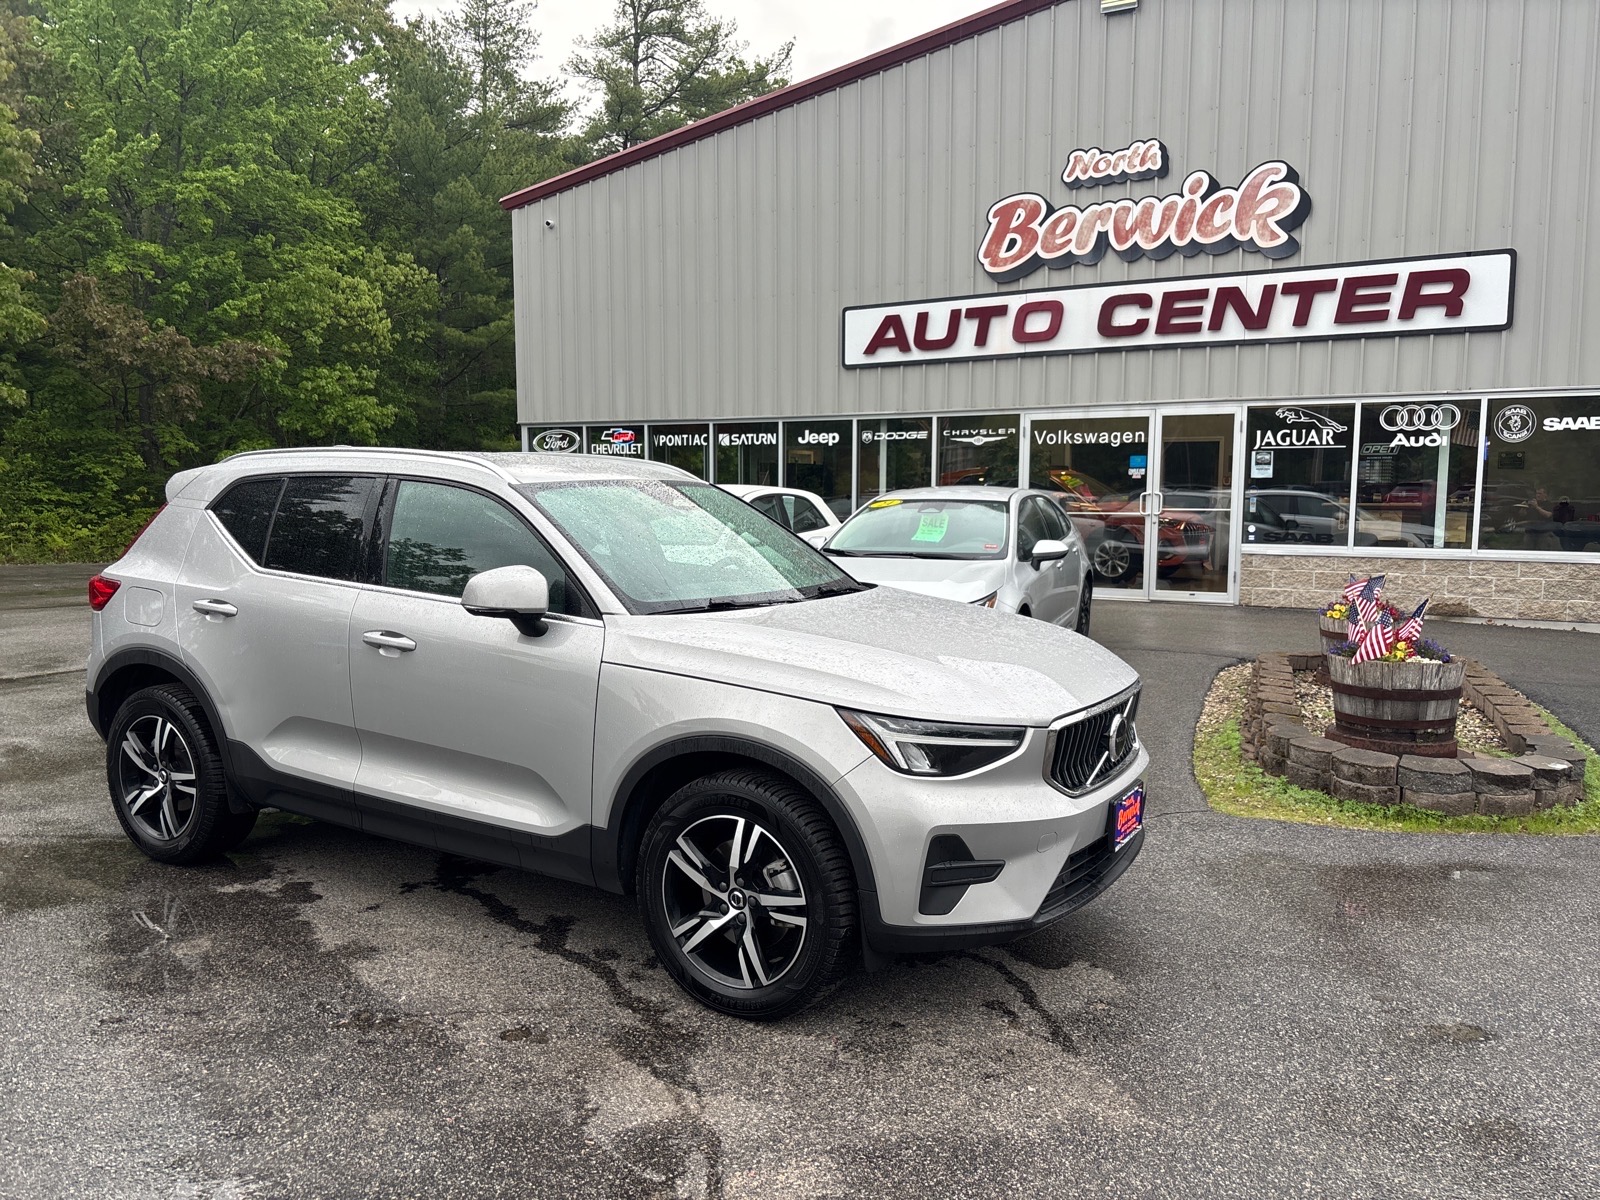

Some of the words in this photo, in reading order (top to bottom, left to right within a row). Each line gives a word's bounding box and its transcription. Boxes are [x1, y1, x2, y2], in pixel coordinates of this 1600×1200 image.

[1064, 141, 1163, 181] North
[980, 163, 1298, 271] Berwick
[862, 300, 1064, 355] AUTO
[1096, 268, 1471, 337] CENTER
[1504, 407, 1527, 416] SAAB
[613, 432, 635, 441] OPEN
[797, 429, 840, 446] Jeep
[874, 431, 929, 441] DODGE
[943, 428, 1016, 436] CHRYSLER
[1034, 429, 1146, 447] Volkswagen
[1503, 430, 1528, 439] SCANIA
[543, 434, 570, 450] Ford
[659, 433, 708, 447] PONTIAC
[731, 433, 777, 446] SATURN
[1253, 428, 1335, 450] JAGUAR
[1388, 432, 1448, 447] Audi
[591, 443, 643, 455] CHEVROLET
[1362, 445, 1399, 454] OPEN
[922, 518, 946, 529] SALE
[1263, 532, 1334, 543] SAAB
